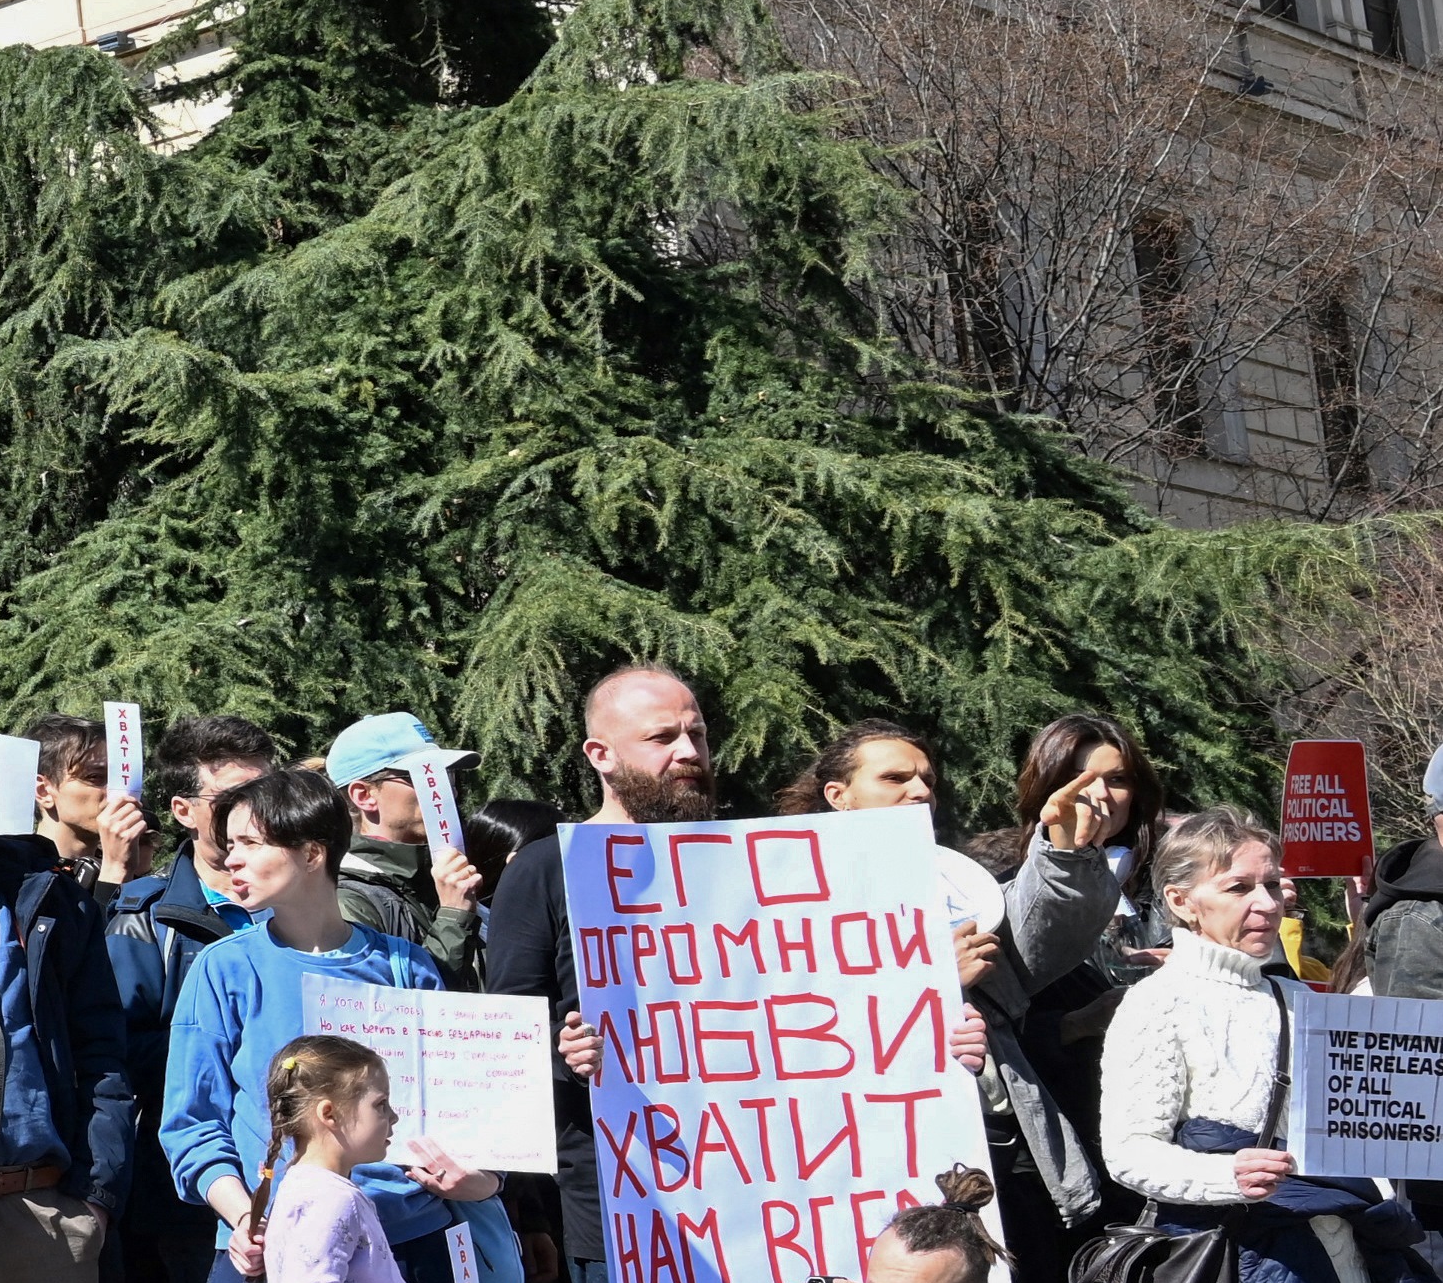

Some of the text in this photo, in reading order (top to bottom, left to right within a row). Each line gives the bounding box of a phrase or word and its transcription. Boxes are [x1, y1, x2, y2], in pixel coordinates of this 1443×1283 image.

[118, 708, 129, 786] ХВАТИТ
[1290, 774, 1345, 795] FREE ALL
[423, 763, 450, 844] ХВАТИТ
[1286, 797, 1354, 819] POLITICAL
[1283, 821, 1362, 844] PRISONERS
[605, 829, 830, 914] ЕГО
[579, 903, 932, 988] ОГРОМНОЙ
[593, 987, 946, 1088] ЛЮБВИ
[1328, 1029, 1443, 1054] WE DEMAN
[1328, 1052, 1443, 1077] THE RELEAS
[1327, 1074, 1392, 1096] OF ALL
[1327, 1097, 1427, 1120] POLITICAL
[596, 1088, 942, 1199] ХВАТИТ
[1327, 1120, 1441, 1143] PRISONERS!
